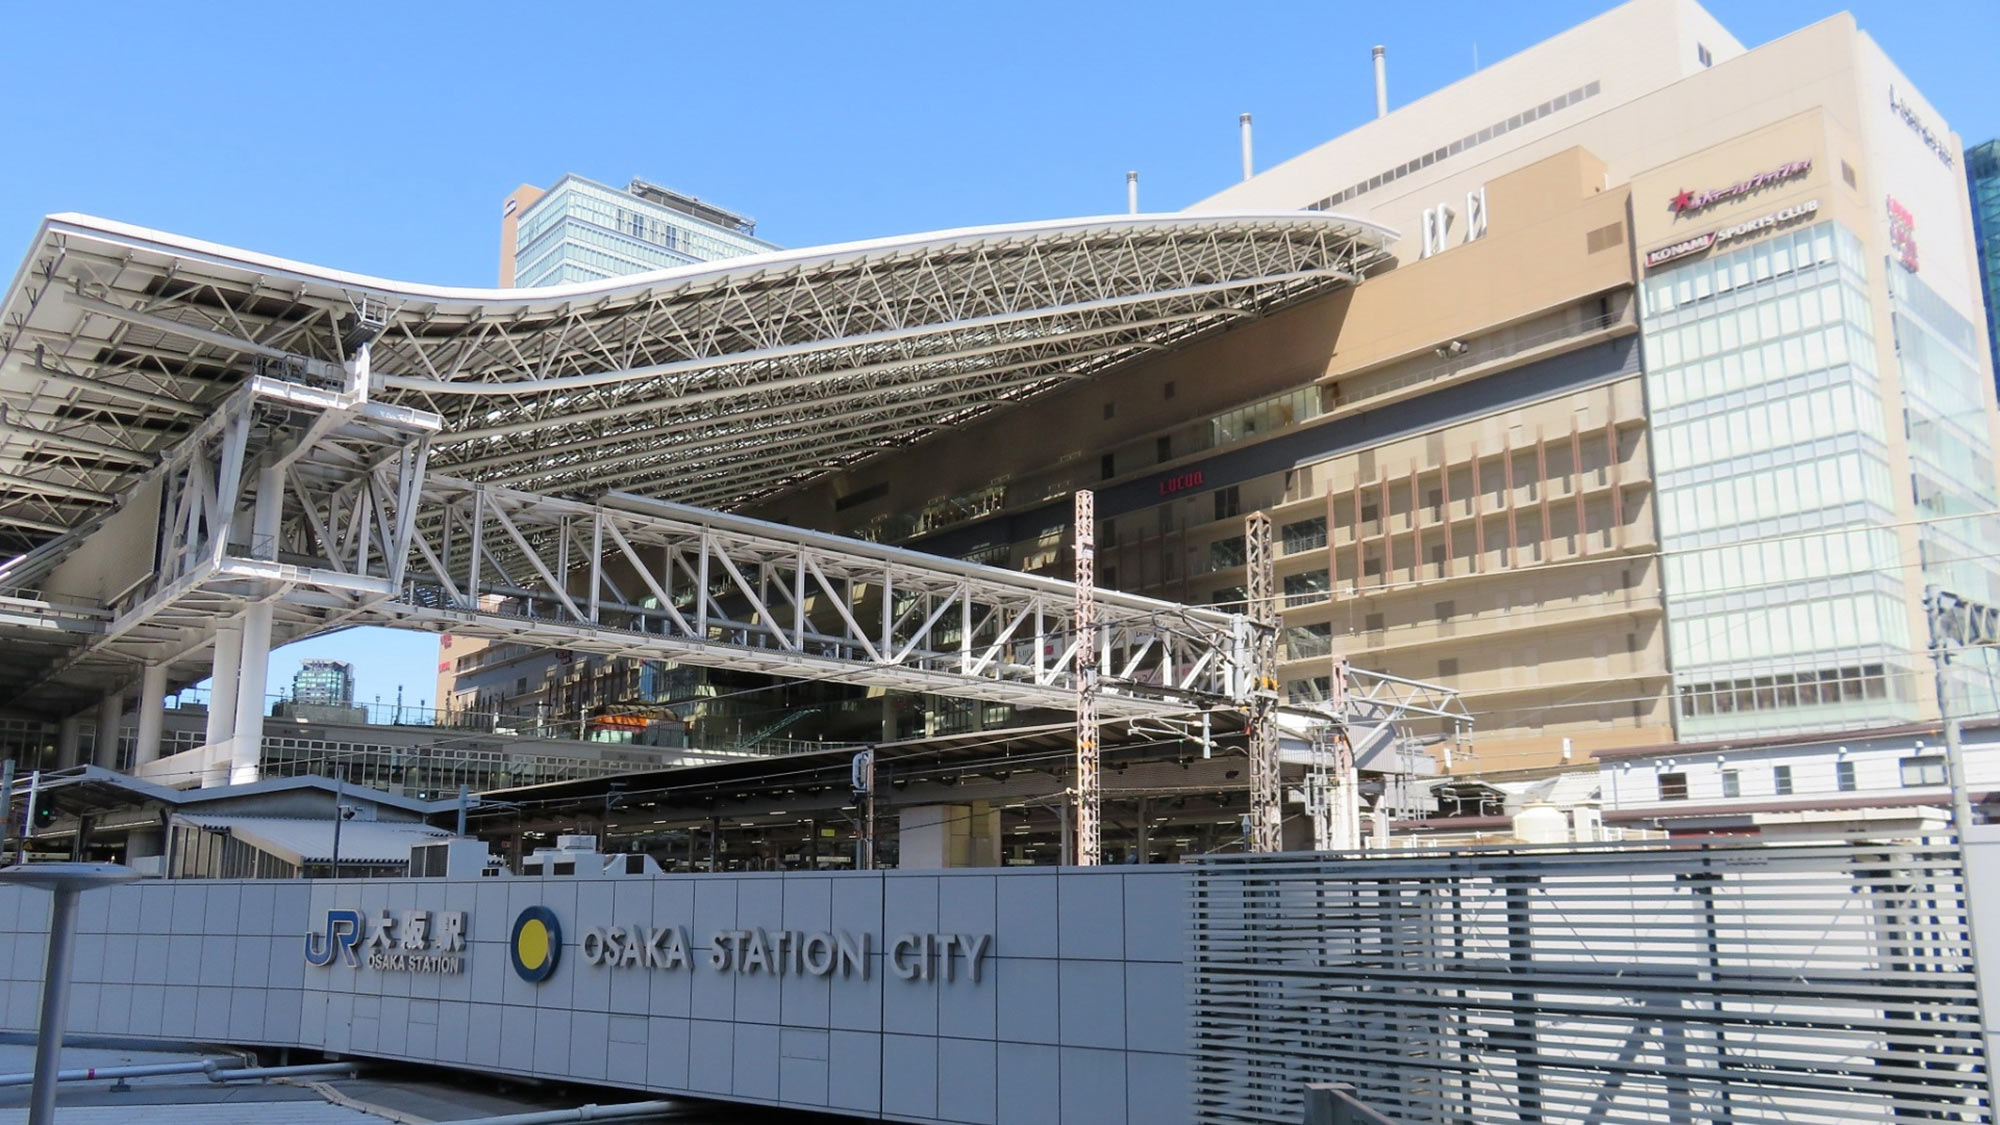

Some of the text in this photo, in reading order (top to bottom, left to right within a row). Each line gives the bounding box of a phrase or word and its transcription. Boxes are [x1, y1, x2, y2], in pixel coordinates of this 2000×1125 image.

[1651, 200, 1818, 262] KONAMI SPORTS CLUB
[305, 909, 364, 967] JR
[369, 909, 467, 951] 大阪駅
[584, 925, 991, 983] OSAKA STATION CITY
[369, 953, 462, 975] OSAKA STATION
